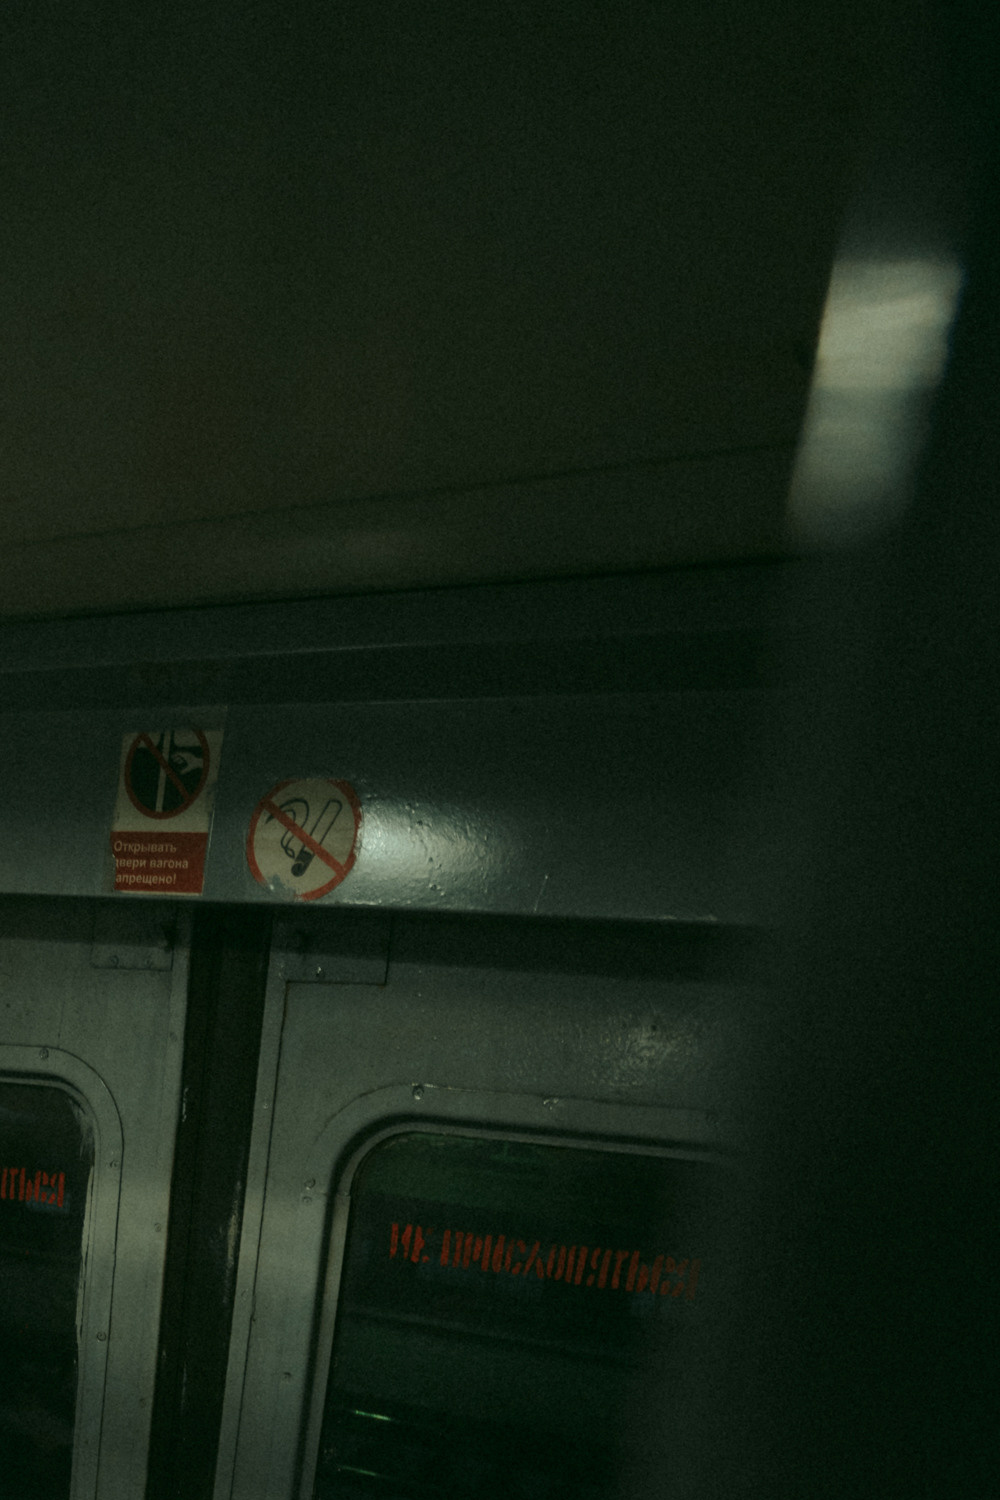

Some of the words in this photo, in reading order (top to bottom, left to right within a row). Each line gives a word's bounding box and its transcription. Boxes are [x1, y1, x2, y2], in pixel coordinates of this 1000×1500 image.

[113, 840, 177, 854] Открывать
[149, 859, 189, 870] вагона
[115, 873, 177, 886] апрещено!
